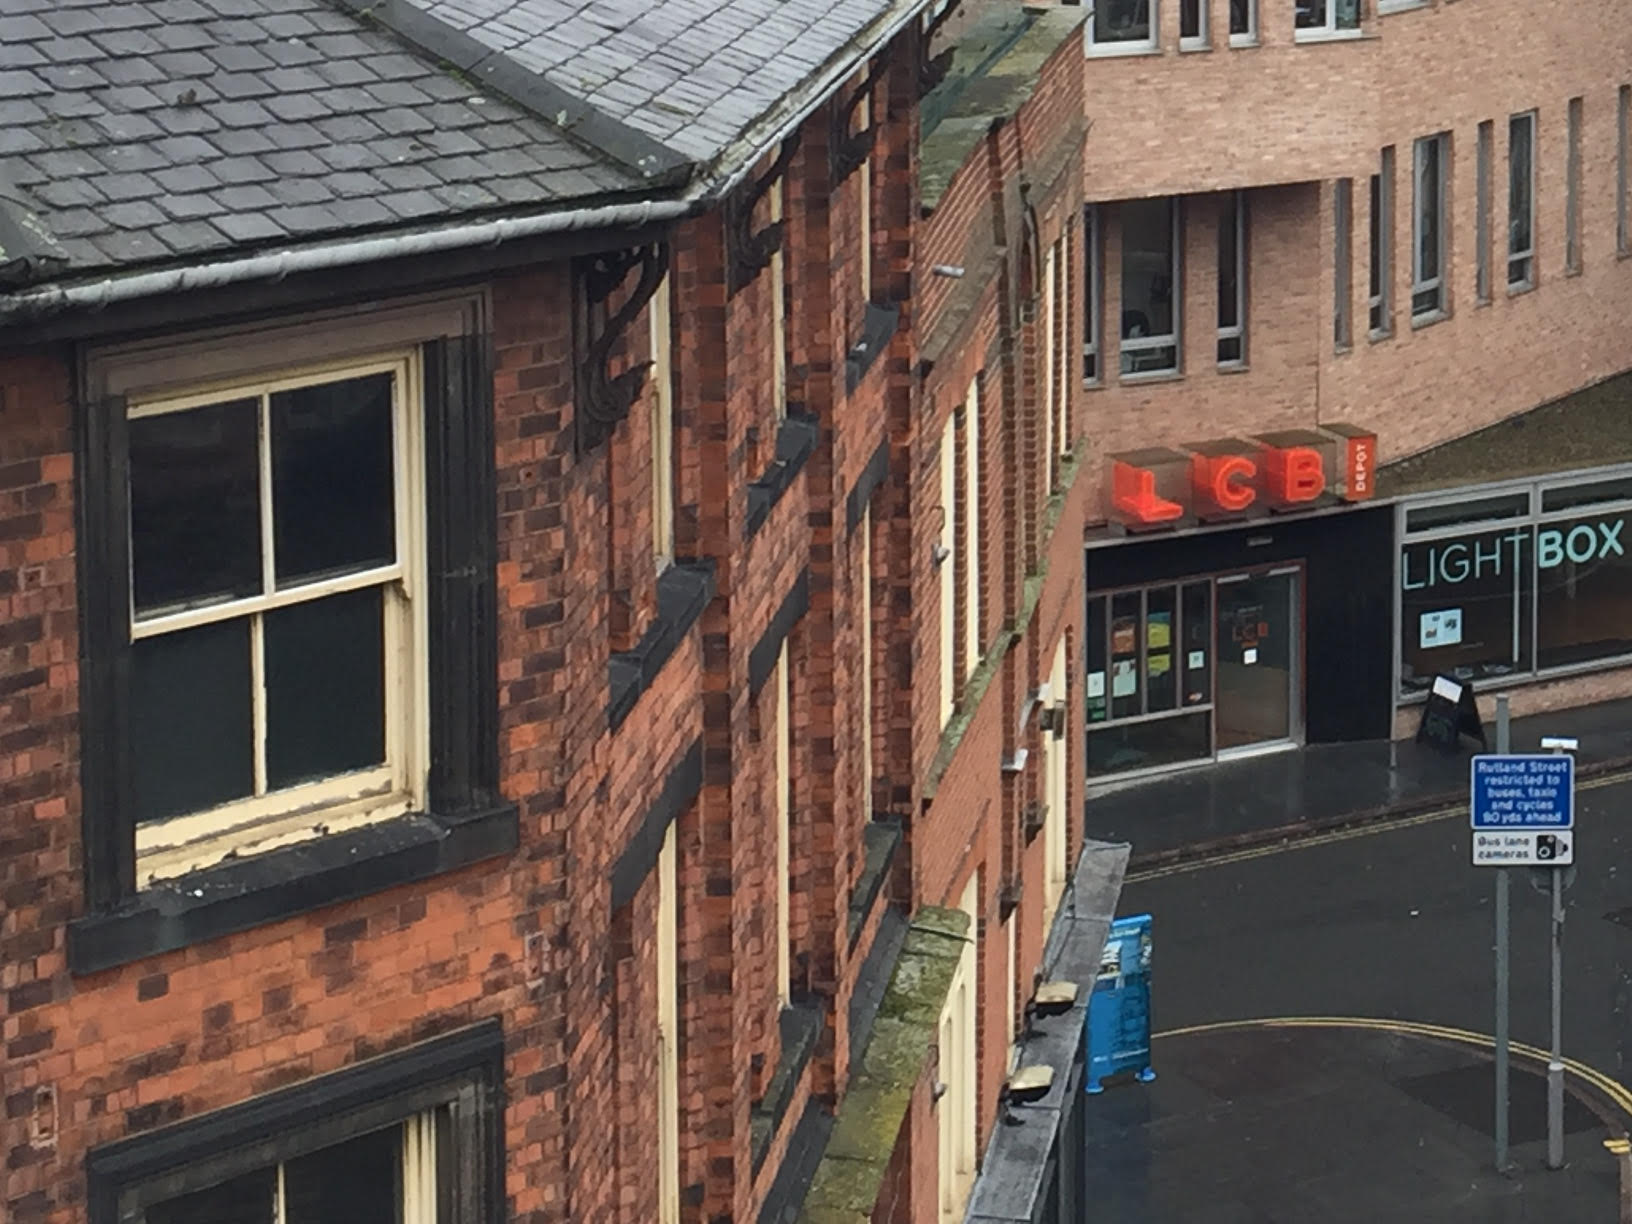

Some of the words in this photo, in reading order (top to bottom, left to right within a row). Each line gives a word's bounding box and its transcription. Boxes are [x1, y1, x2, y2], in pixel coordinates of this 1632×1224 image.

[1112, 445, 1326, 524] LCB
[1354, 443, 1368, 492] DEPOT
[1478, 761, 1526, 773] Rutland
[1529, 761, 1568, 773] Street
[1484, 775, 1544, 786] restricted
[1547, 775, 1561, 785] to
[1528, 787, 1558, 798] taxis
[1491, 799, 1514, 811] and
[1516, 800, 1555, 812] cycles
[1501, 812, 1523, 824] yds
[1525, 811, 1563, 823] ahead
[1477, 836, 1501, 847] Bus
[1504, 836, 1530, 847] lane
[1477, 850, 1529, 860] cameras
